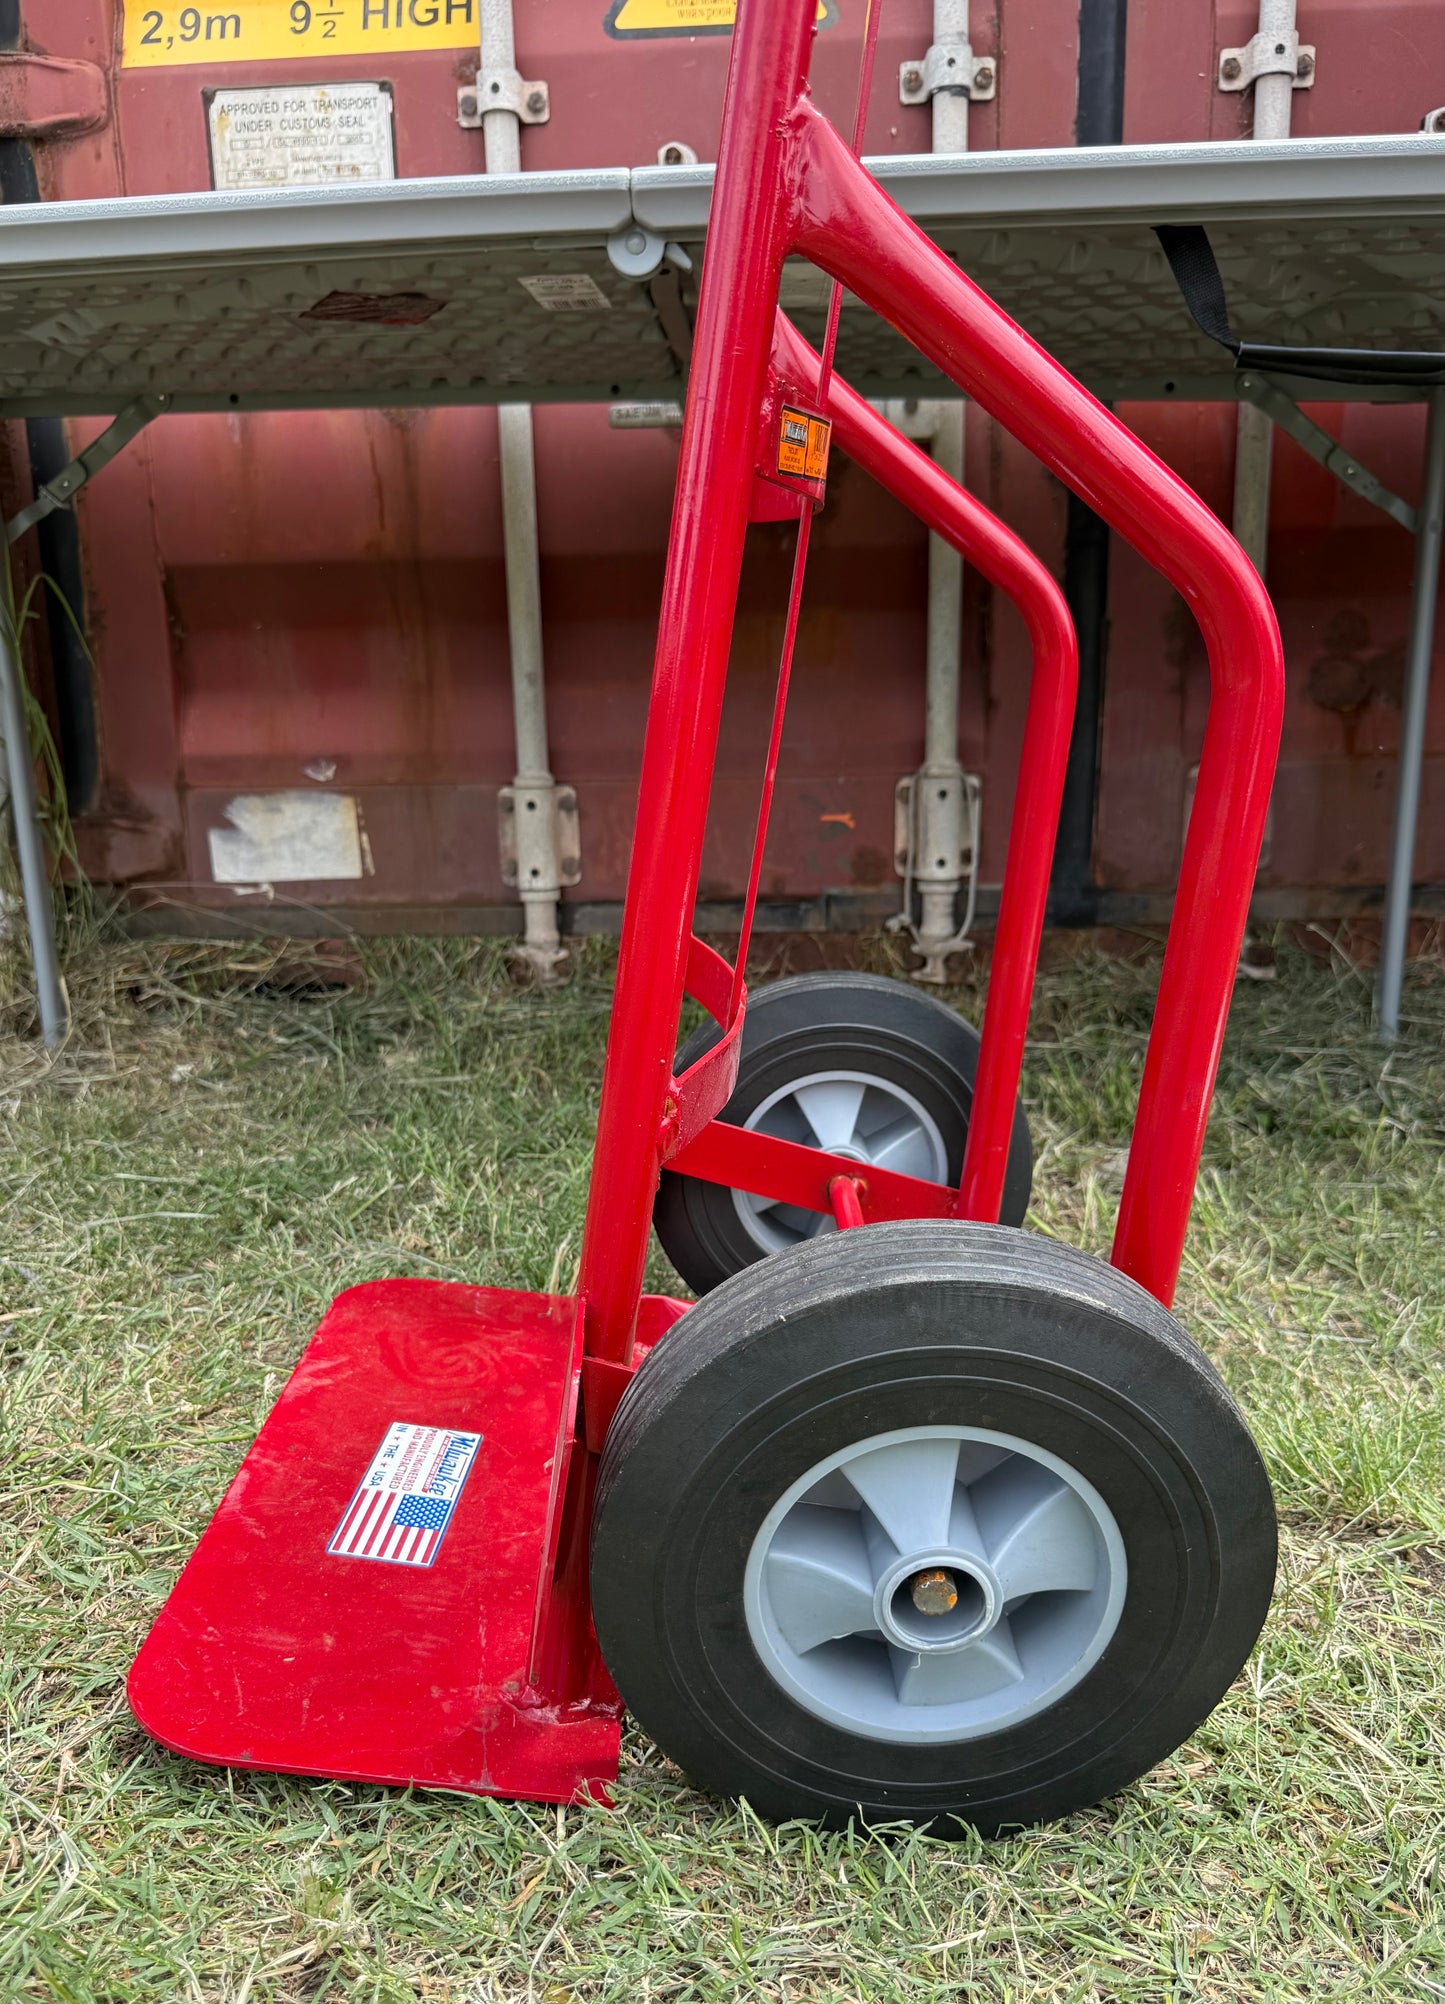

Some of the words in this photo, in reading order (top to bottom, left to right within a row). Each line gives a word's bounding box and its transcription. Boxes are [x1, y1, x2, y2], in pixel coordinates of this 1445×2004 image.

[140, 7, 240, 50] 2,9m
[362, 0, 472, 30] HIGH
[220, 101, 279, 116] APPROVED
[283, 100, 306, 113] FOR
[312, 97, 378, 112] TRANSPORT
[235, 119, 273, 133] UNDER
[280, 116, 331, 131] CUSTOMS
[338, 114, 365, 128] SEAL
[413, 1427, 425, 1440] AND
[419, 1429, 438, 1454] PROUDLY
[383, 1444, 399, 1458] THE
[389, 1441, 419, 1489] MANUFACTURED
[402, 1455, 426, 1491] ENGINEERED
[429, 1431, 476, 1496] Milwaukee
[369, 1470, 386, 1486] USA
